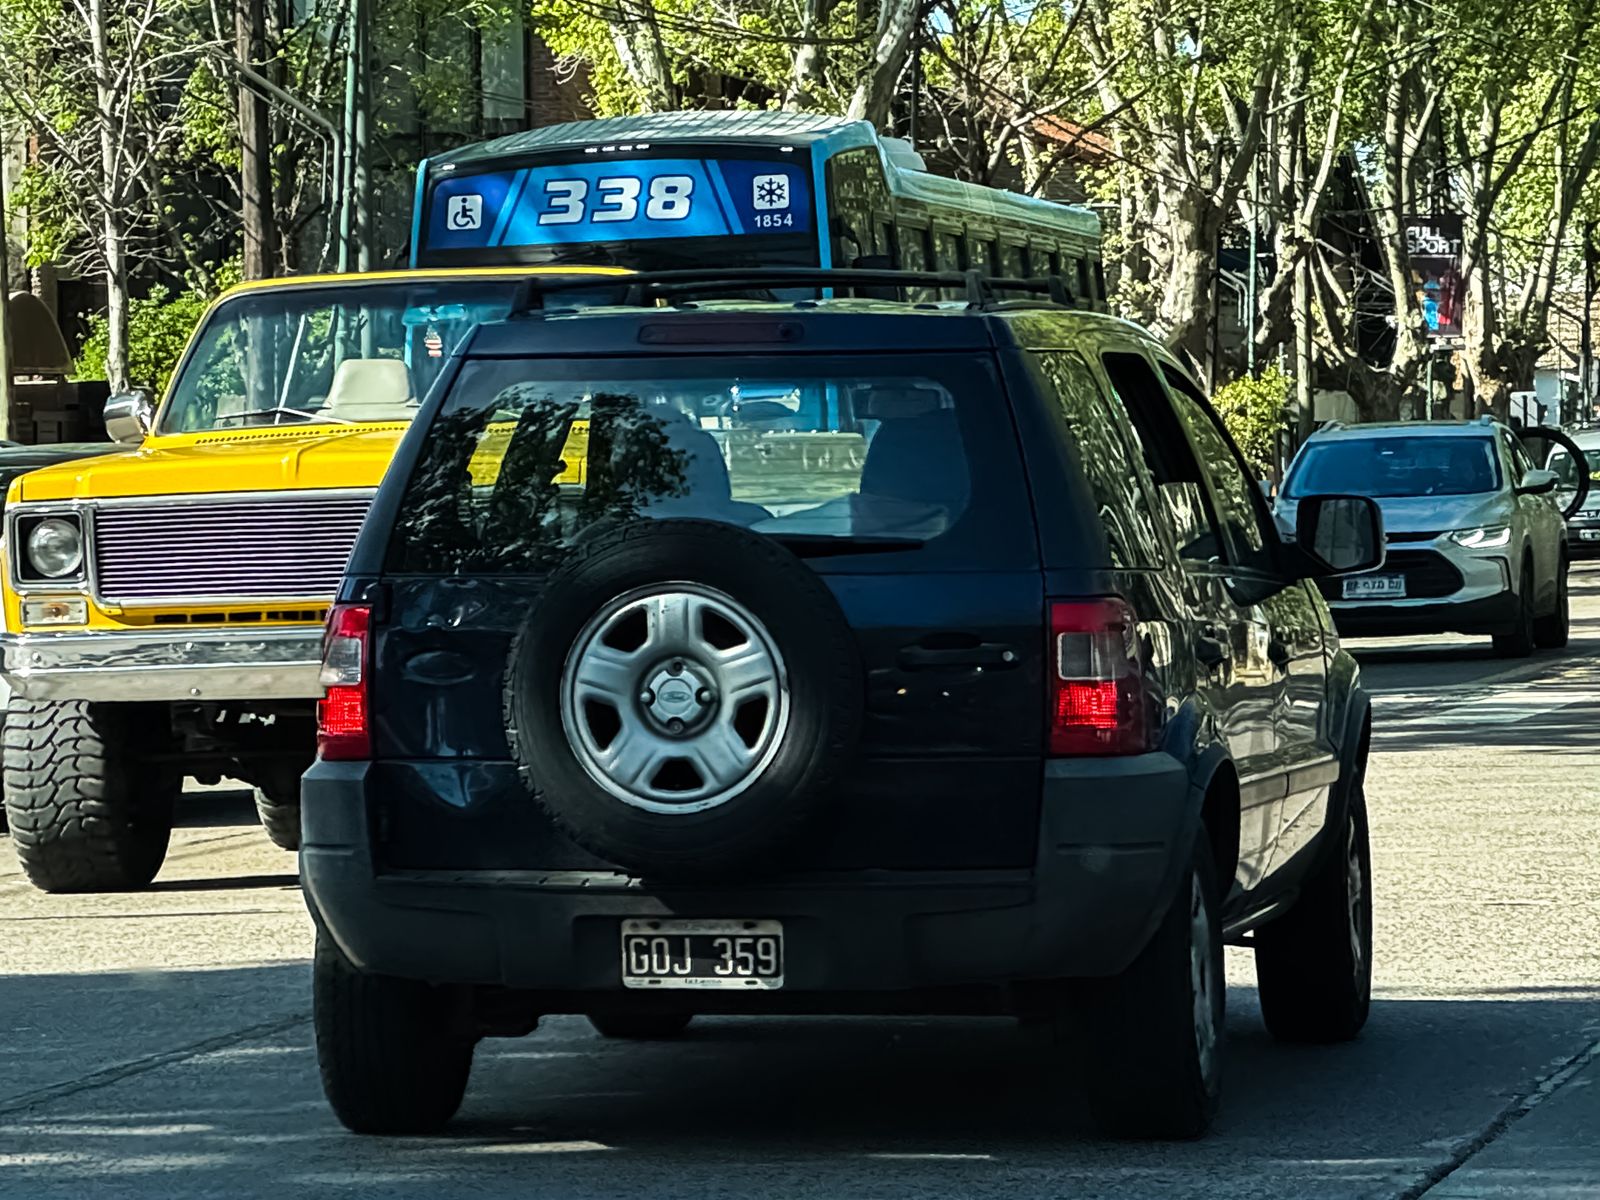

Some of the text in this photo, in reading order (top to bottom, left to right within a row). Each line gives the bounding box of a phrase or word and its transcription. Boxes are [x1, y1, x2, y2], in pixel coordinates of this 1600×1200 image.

[537, 175, 694, 225] 338
[754, 213, 793, 228] 1854
[1406, 226, 1445, 240] FULL
[1407, 239, 1461, 253] SPORT
[629, 937, 777, 975] GOJ 359
